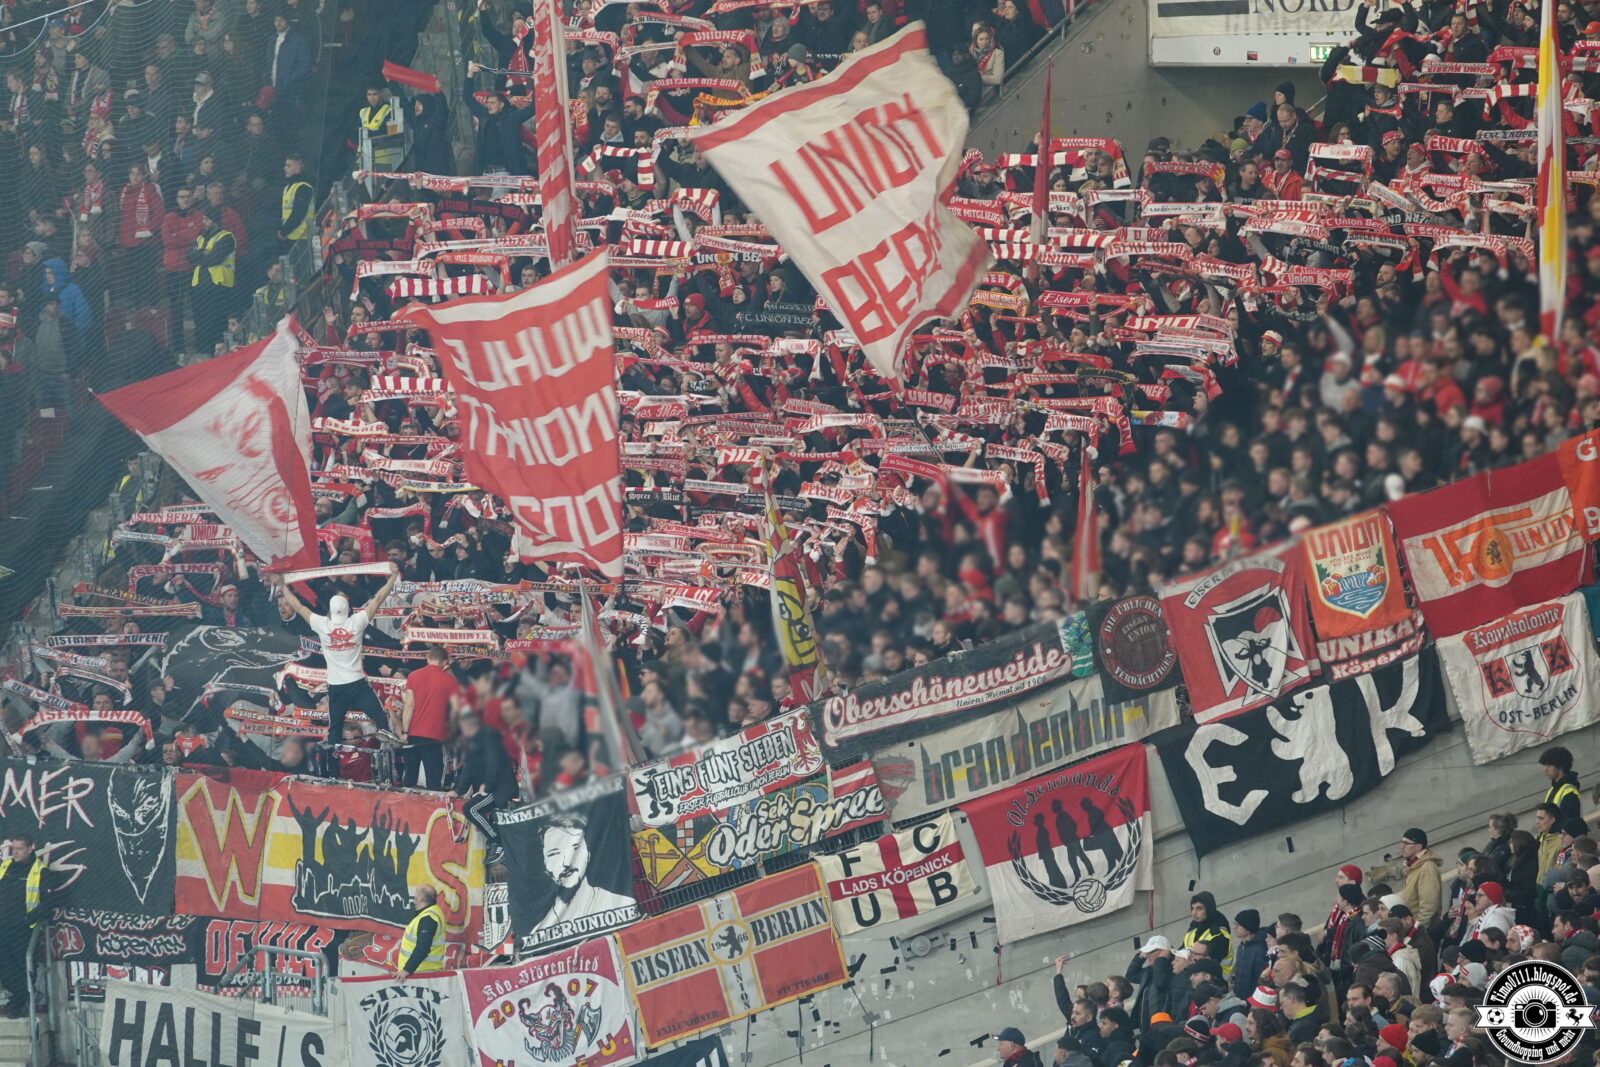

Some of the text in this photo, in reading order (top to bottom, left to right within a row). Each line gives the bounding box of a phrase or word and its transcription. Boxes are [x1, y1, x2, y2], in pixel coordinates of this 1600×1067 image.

[694, 30, 746, 42] UNIONER
[1465, 66, 1494, 74] UNION
[768, 91, 945, 236] UNION
[1334, 218, 1362, 227] Union
[1288, 273, 1315, 285] Union
[1043, 291, 1081, 305] Eisern
[755, 314, 792, 324] UNION
[1308, 515, 1381, 561] UNION
[1104, 599, 1164, 633] DIE ÜBLICHEN
[1127, 622, 1157, 643] UNION
[1114, 650, 1174, 686] VERDÄCHTIGEN
[822, 641, 1070, 736] Oberschöneweide
[956, 696, 984, 709] Unions
[985, 685, 1013, 700] Heimat
[1499, 683, 1579, 724] OST-BERLIN
[653, 726, 797, 801] EINS FÜNF SIEBEN
[677, 797, 702, 814] ERSTER
[767, 762, 792, 784] BERLIN
[496, 801, 555, 826] EINMAL
[706, 784, 887, 868] Oder Spree
[178, 775, 283, 913] W
[913, 822, 942, 854] C
[839, 853, 953, 897] LADS KÖPENICK
[850, 870, 959, 928] U B
[521, 921, 575, 950] IMMER
[630, 897, 828, 987] EISERN BERLIN
[736, 932, 749, 944] 66
[518, 951, 600, 986] Störenfried
[360, 985, 450, 1012] SIXTY
[487, 977, 601, 1030] 20 07
[731, 964, 751, 1011] UNION
